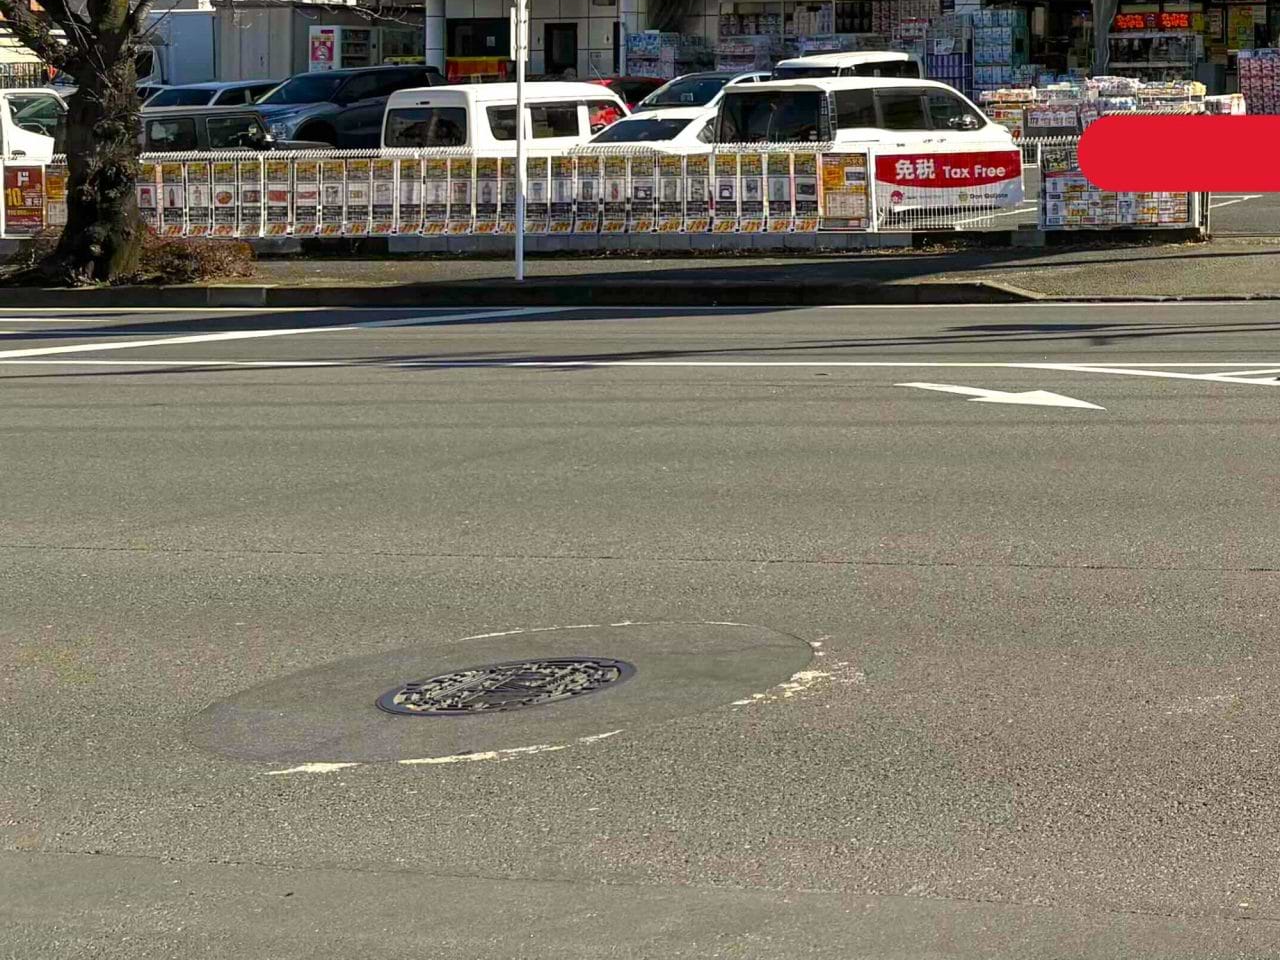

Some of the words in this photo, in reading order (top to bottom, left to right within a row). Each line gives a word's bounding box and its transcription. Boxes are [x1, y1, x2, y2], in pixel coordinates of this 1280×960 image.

[895, 158, 936, 180] 免税
[942, 165, 970, 179] Tax
[974, 164, 1006, 178] Free
